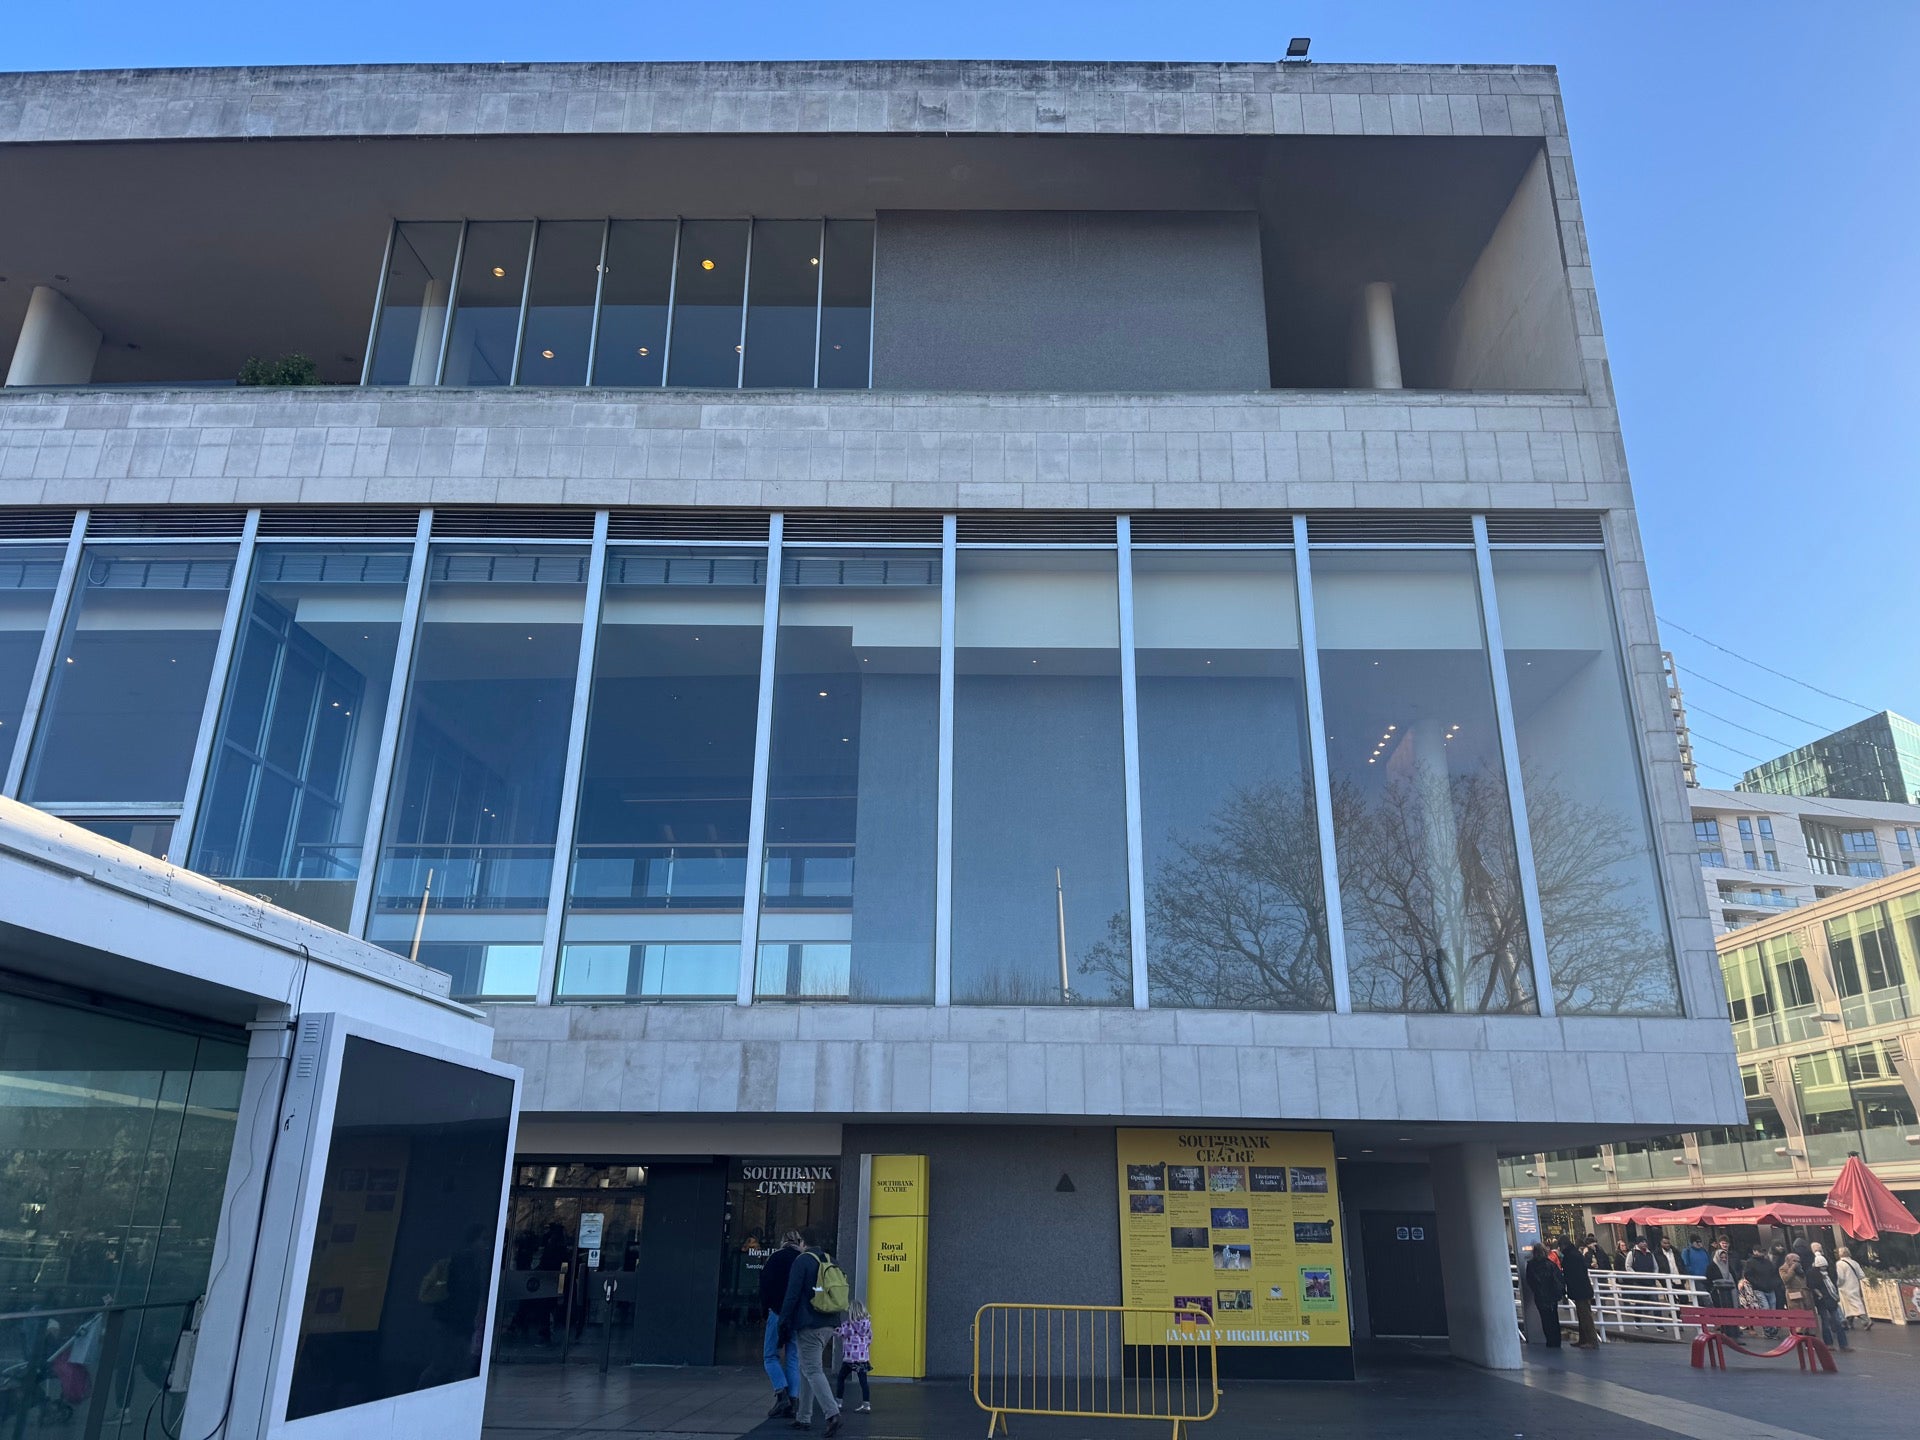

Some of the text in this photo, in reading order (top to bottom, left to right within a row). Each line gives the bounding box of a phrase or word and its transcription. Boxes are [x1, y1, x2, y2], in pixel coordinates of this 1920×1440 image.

[1178, 1135, 1270, 1149] SOUTHBANK
[1196, 1149, 1255, 1163] CENTRE
[743, 1167, 833, 1180] SOUTHBANK
[758, 1181, 816, 1194] CENTRE
[748, 1248, 770, 1258] Royal
[881, 1242, 904, 1252] Royal
[877, 1253, 907, 1262] Festival
[883, 1263, 900, 1272] Hall
[1226, 1329, 1310, 1343] HIGHLIGHTS
